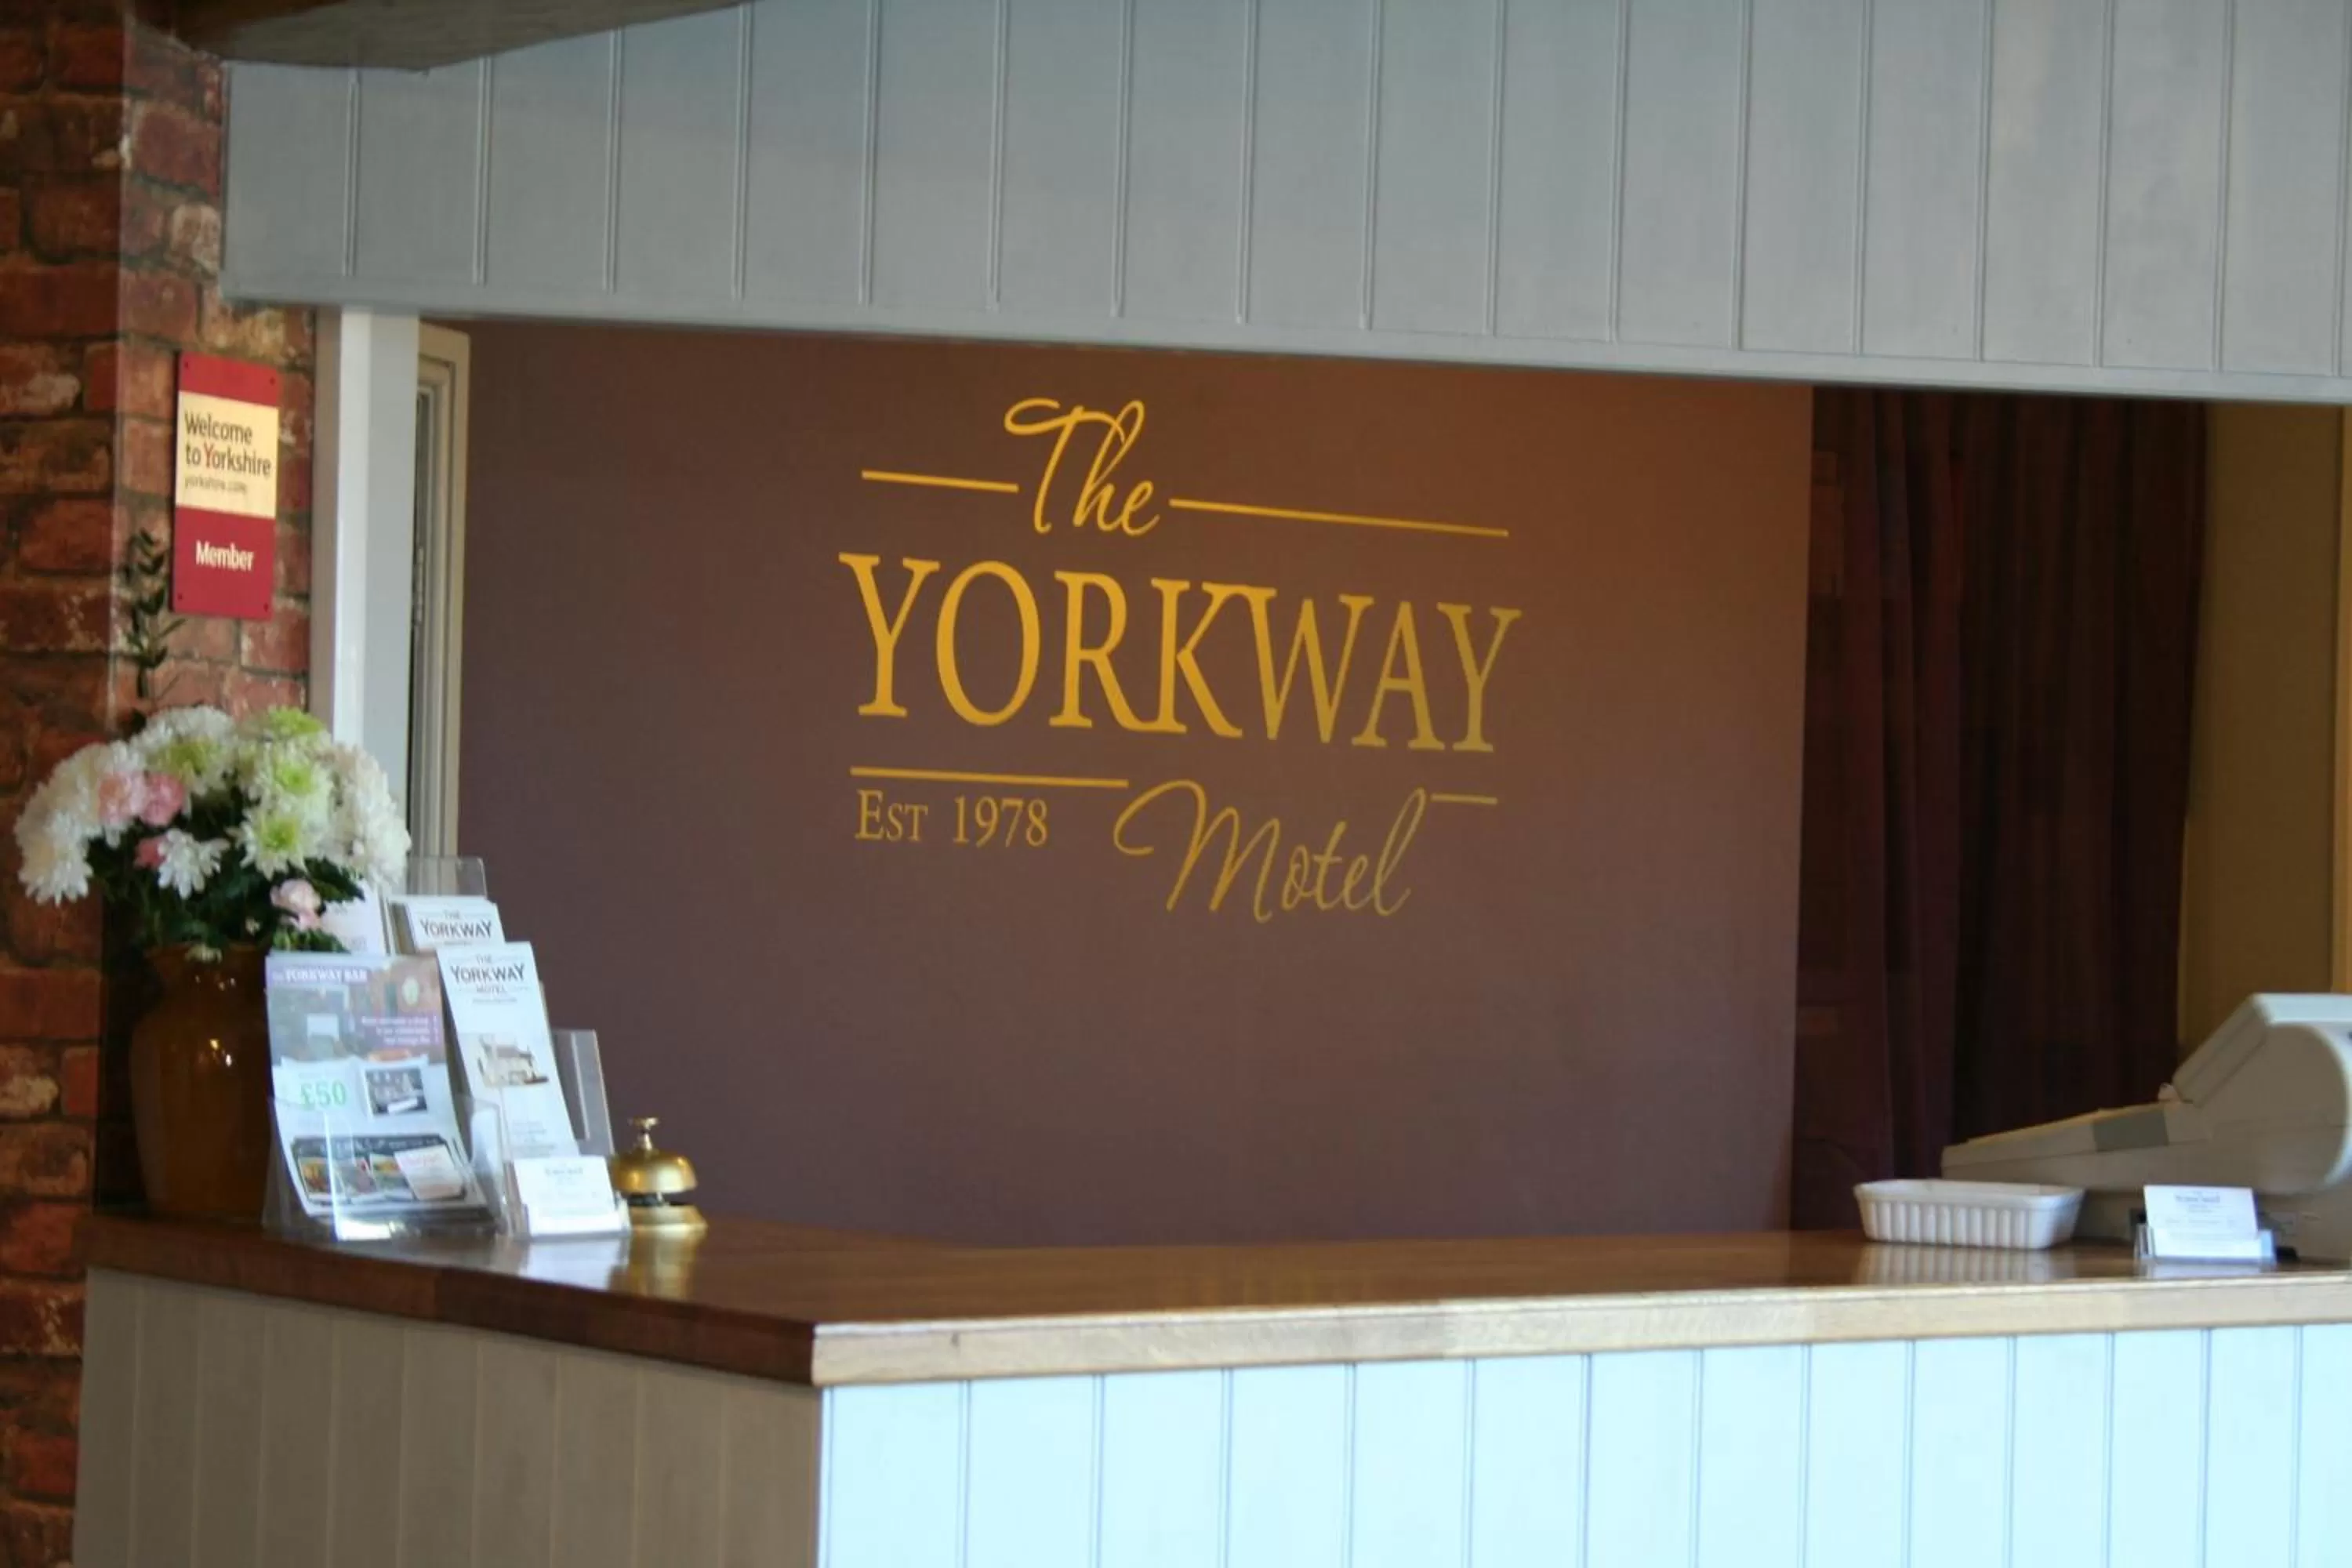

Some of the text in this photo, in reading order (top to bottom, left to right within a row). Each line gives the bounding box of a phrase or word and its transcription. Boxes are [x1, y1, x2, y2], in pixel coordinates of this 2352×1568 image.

[184, 410, 253, 445] Welcome
[185, 441, 272, 480] to Yorkshire
[1003, 397, 1161, 536] The
[195, 539, 254, 572] Member
[837, 551, 1523, 753] YORKWAY
[953, 795, 1048, 848] 1978
[1112, 779, 1426, 924] Motel
[419, 918, 492, 938] YORKWAY
[449, 963, 524, 984] YORKWAY
[299, 1079, 347, 1110] £50
